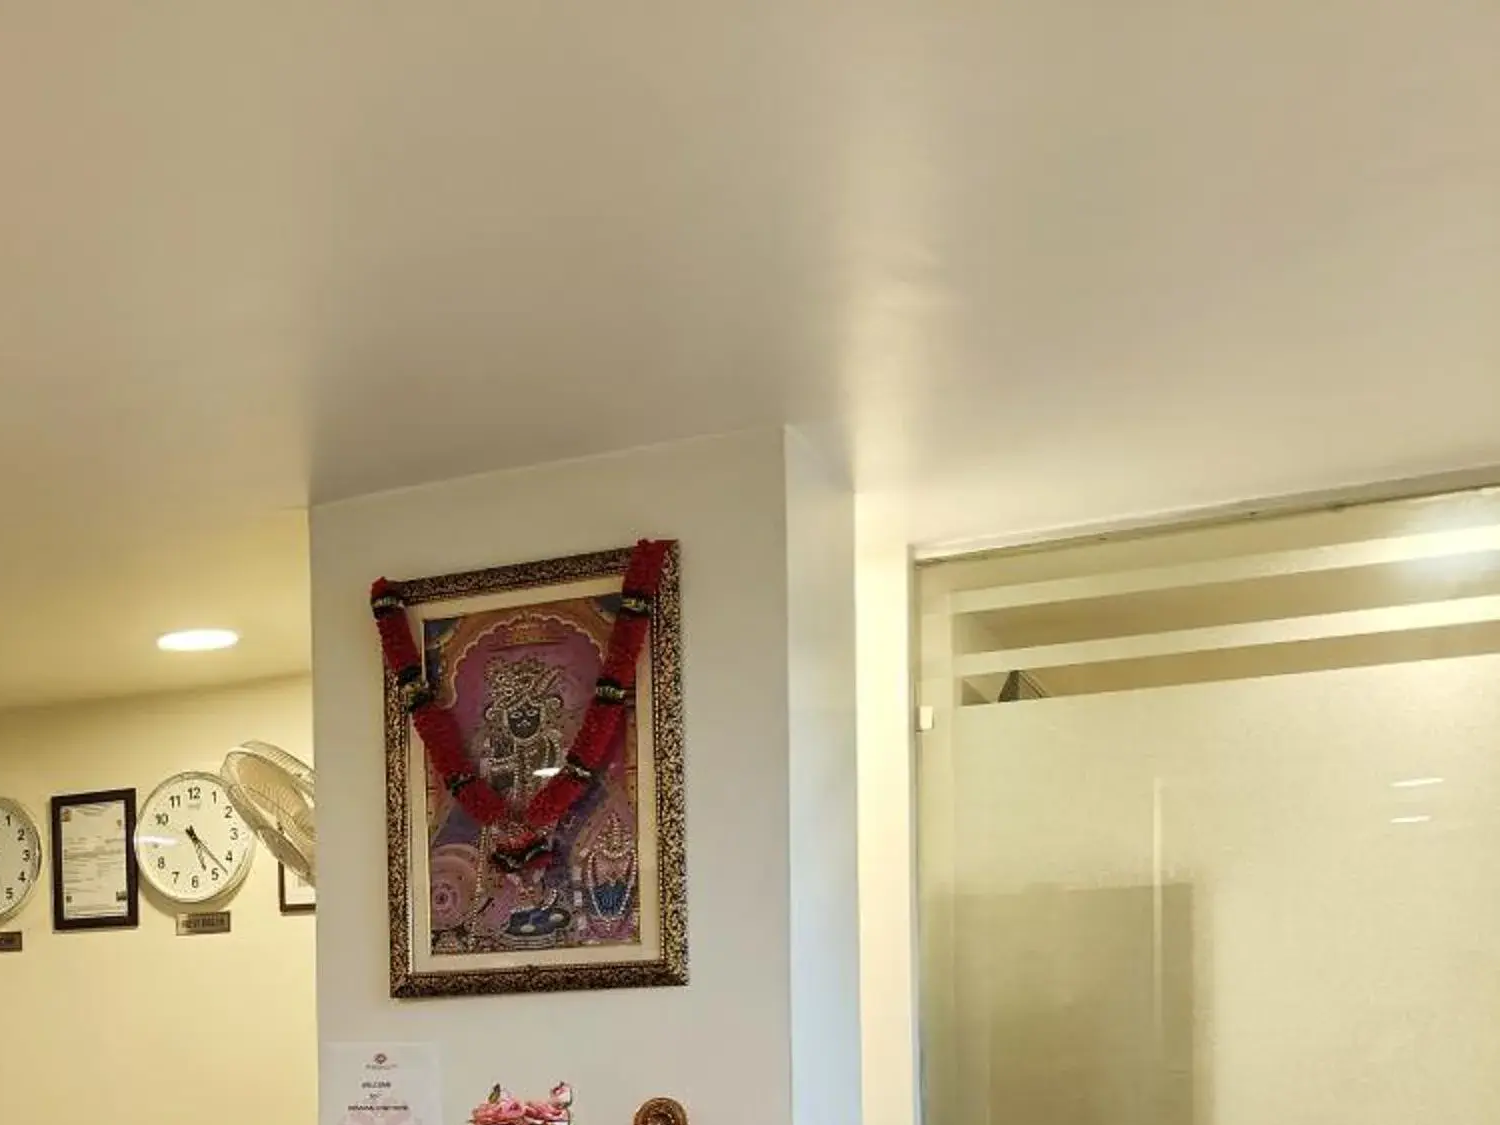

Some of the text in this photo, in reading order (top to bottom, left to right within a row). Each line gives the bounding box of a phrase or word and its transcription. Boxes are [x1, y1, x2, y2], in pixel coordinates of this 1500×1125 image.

[188, 787, 200, 800] 12
[212, 791, 217, 803] 1
[170, 795, 181, 808] 11
[225, 806, 232, 818] 2
[6, 815, 11, 826] 1
[156, 813, 169, 825] 10
[17, 829, 24, 840] 2
[230, 828, 238, 840] 3
[23, 850, 30, 862] 3
[225, 851, 233, 863] 4
[158, 857, 165, 869] 8
[18, 871, 25, 882] 4
[172, 872, 179, 883] 7
[211, 868, 219, 881] 5
[192, 876, 198, 888] 6
[6, 888, 13, 899] 5
